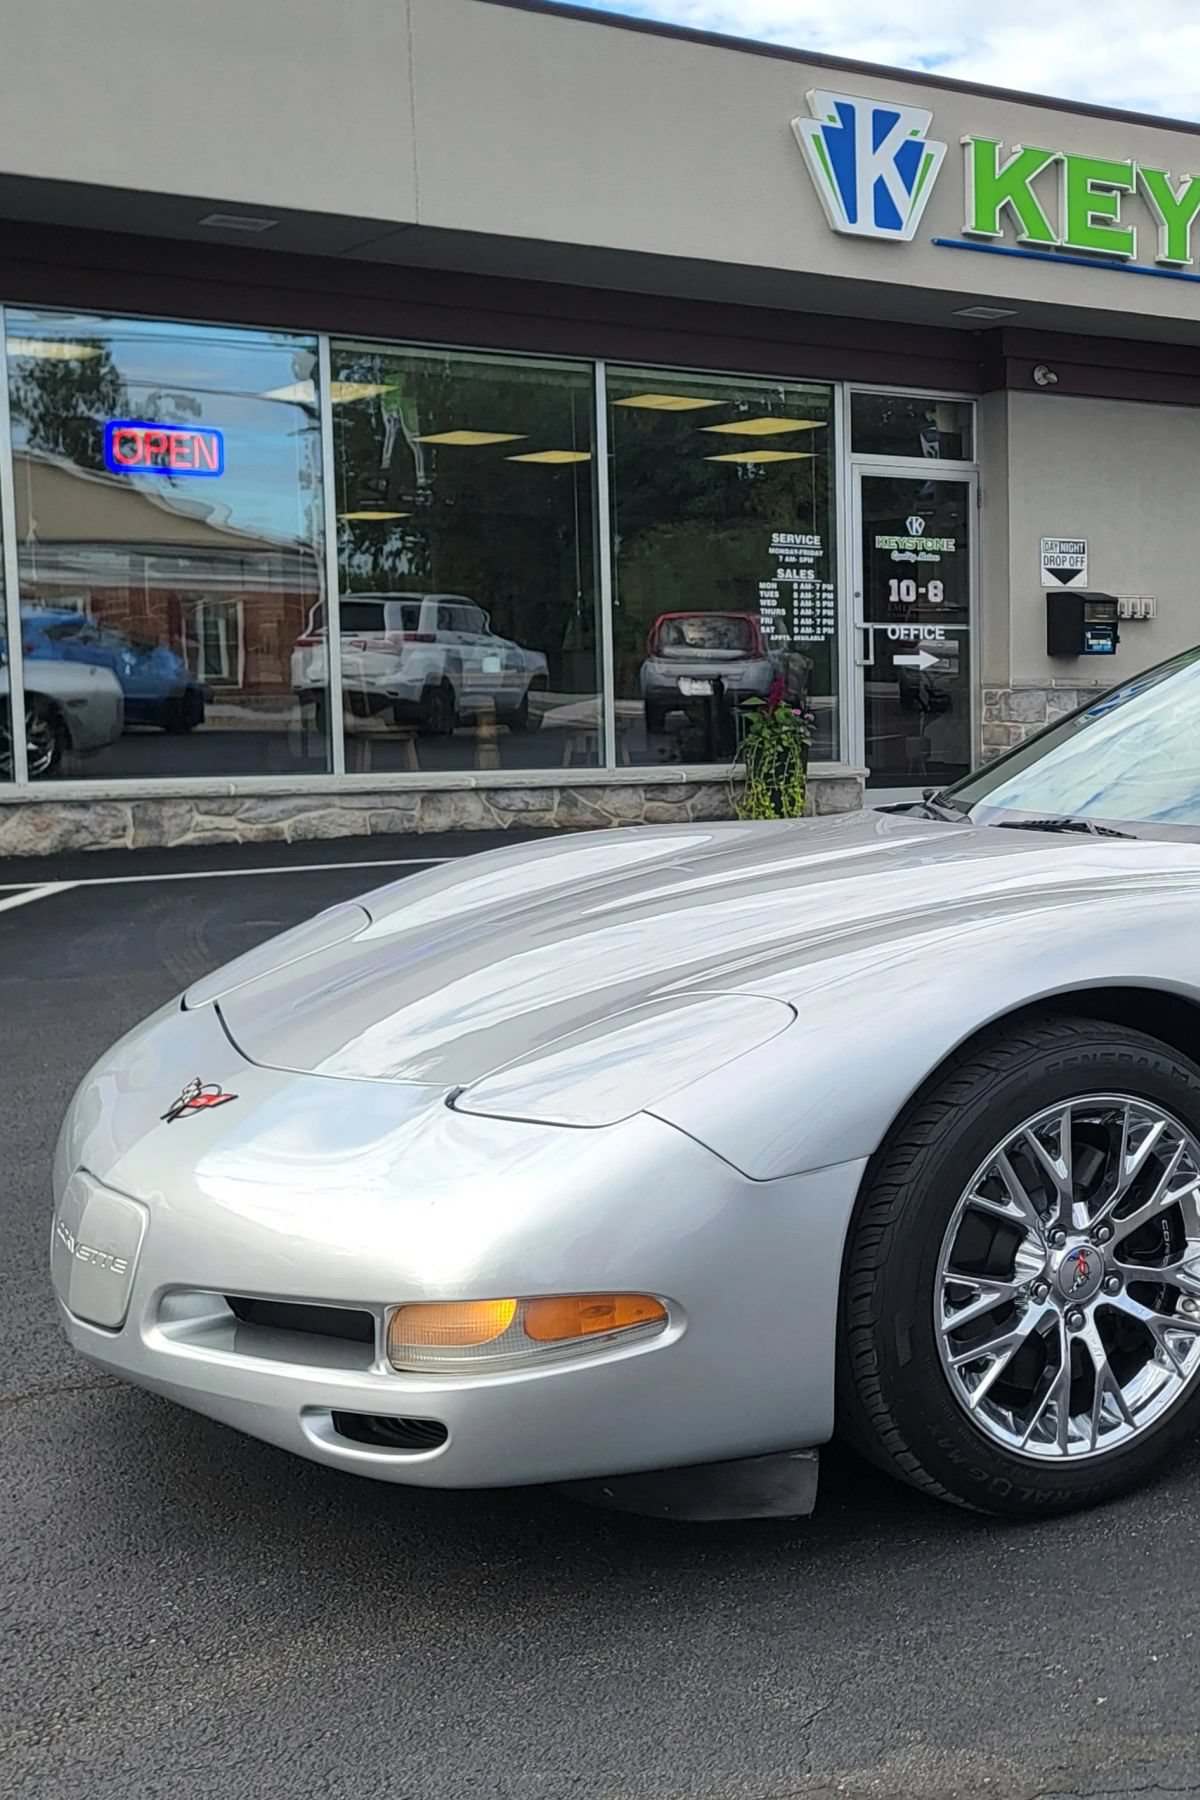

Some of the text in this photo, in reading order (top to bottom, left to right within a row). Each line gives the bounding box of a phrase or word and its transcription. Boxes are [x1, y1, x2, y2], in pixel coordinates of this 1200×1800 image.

[113, 429, 218, 470] OPEN
[771, 533, 821, 545] SERVICE
[875, 535, 955, 552] KEYSTONE
[768, 547, 823, 556] MONDAY-FRIDAY
[1044, 541, 1084, 554] DAY NIGHT
[1043, 555, 1085, 567] DROP OFF
[776, 568, 815, 580] SALES
[759, 582, 777, 590] MON
[760, 608, 786, 616] THURS
[760, 617, 773, 625] FRI
[887, 625, 945, 640] OFFICE
